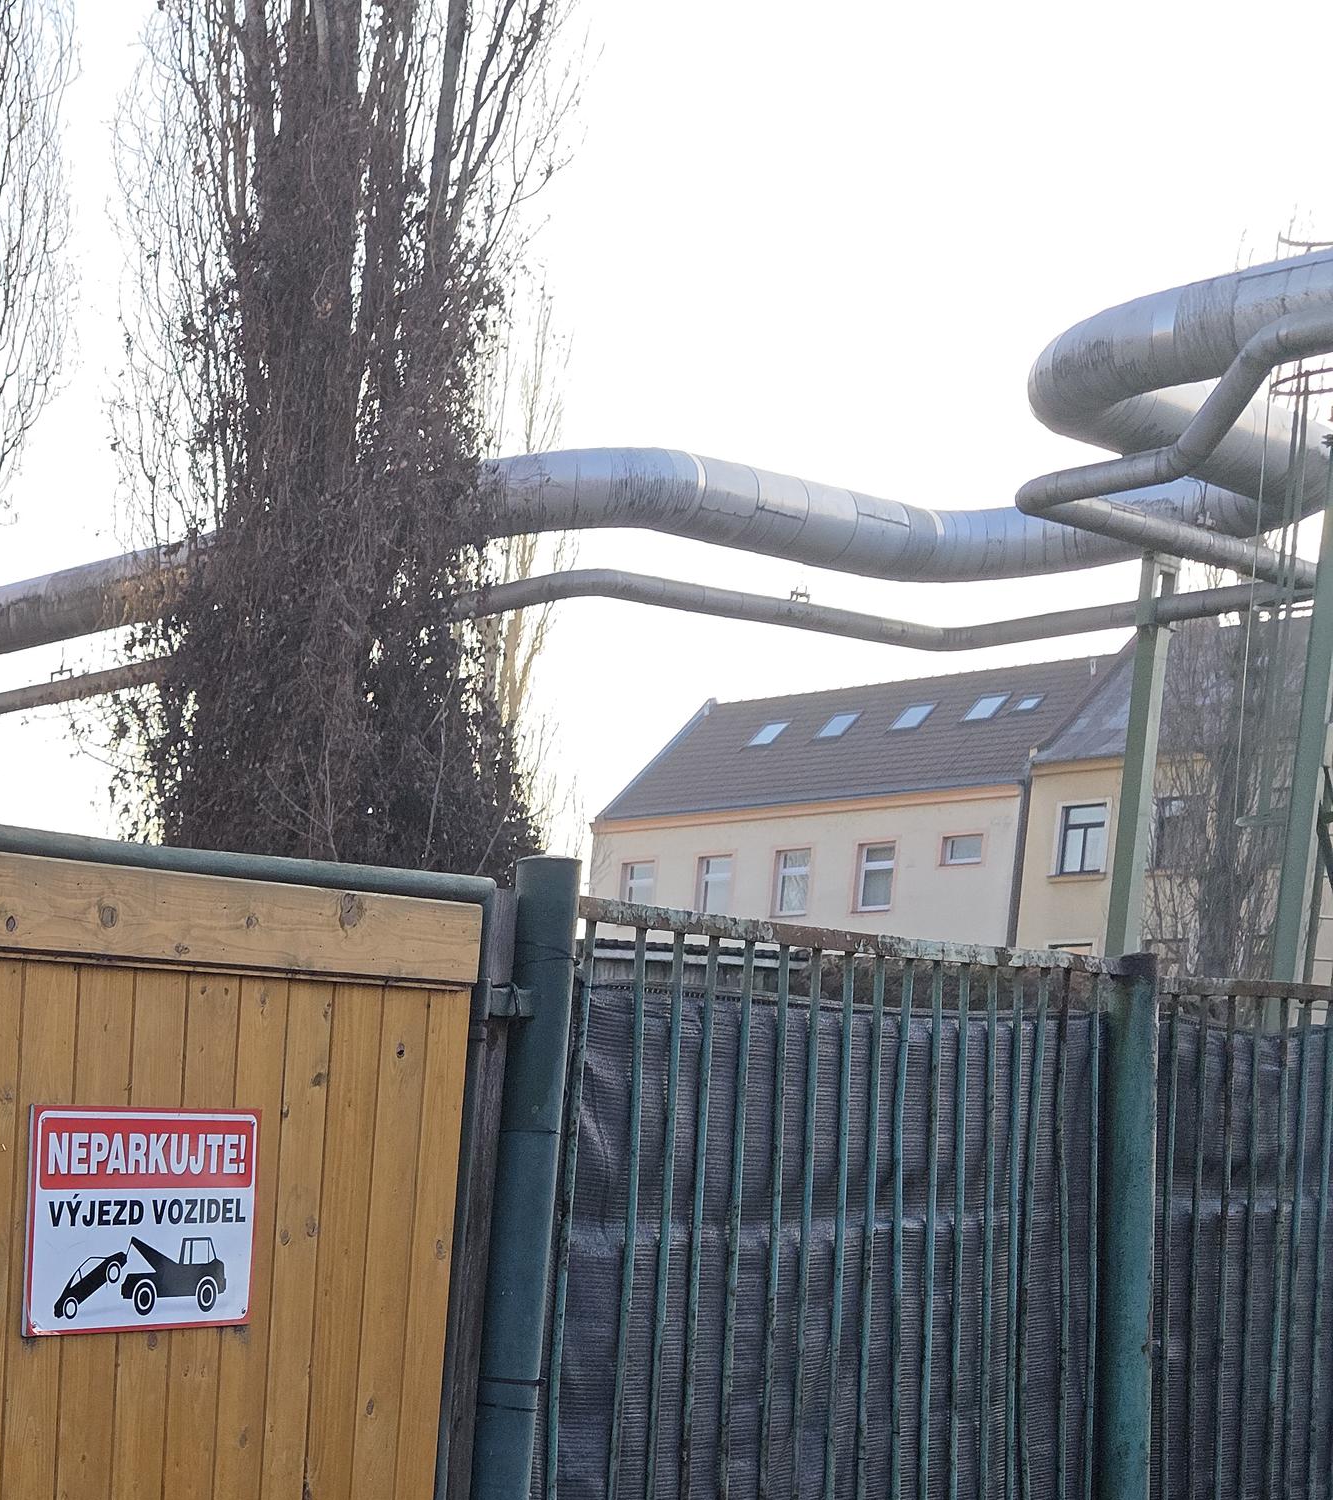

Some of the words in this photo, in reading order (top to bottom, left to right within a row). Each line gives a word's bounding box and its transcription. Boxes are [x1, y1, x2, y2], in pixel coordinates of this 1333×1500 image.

[47, 1132, 246, 1175] NEPARKUJTE!
[48, 1194, 144, 1227] VÝJEZD
[152, 1198, 246, 1225] VOZIDEL
